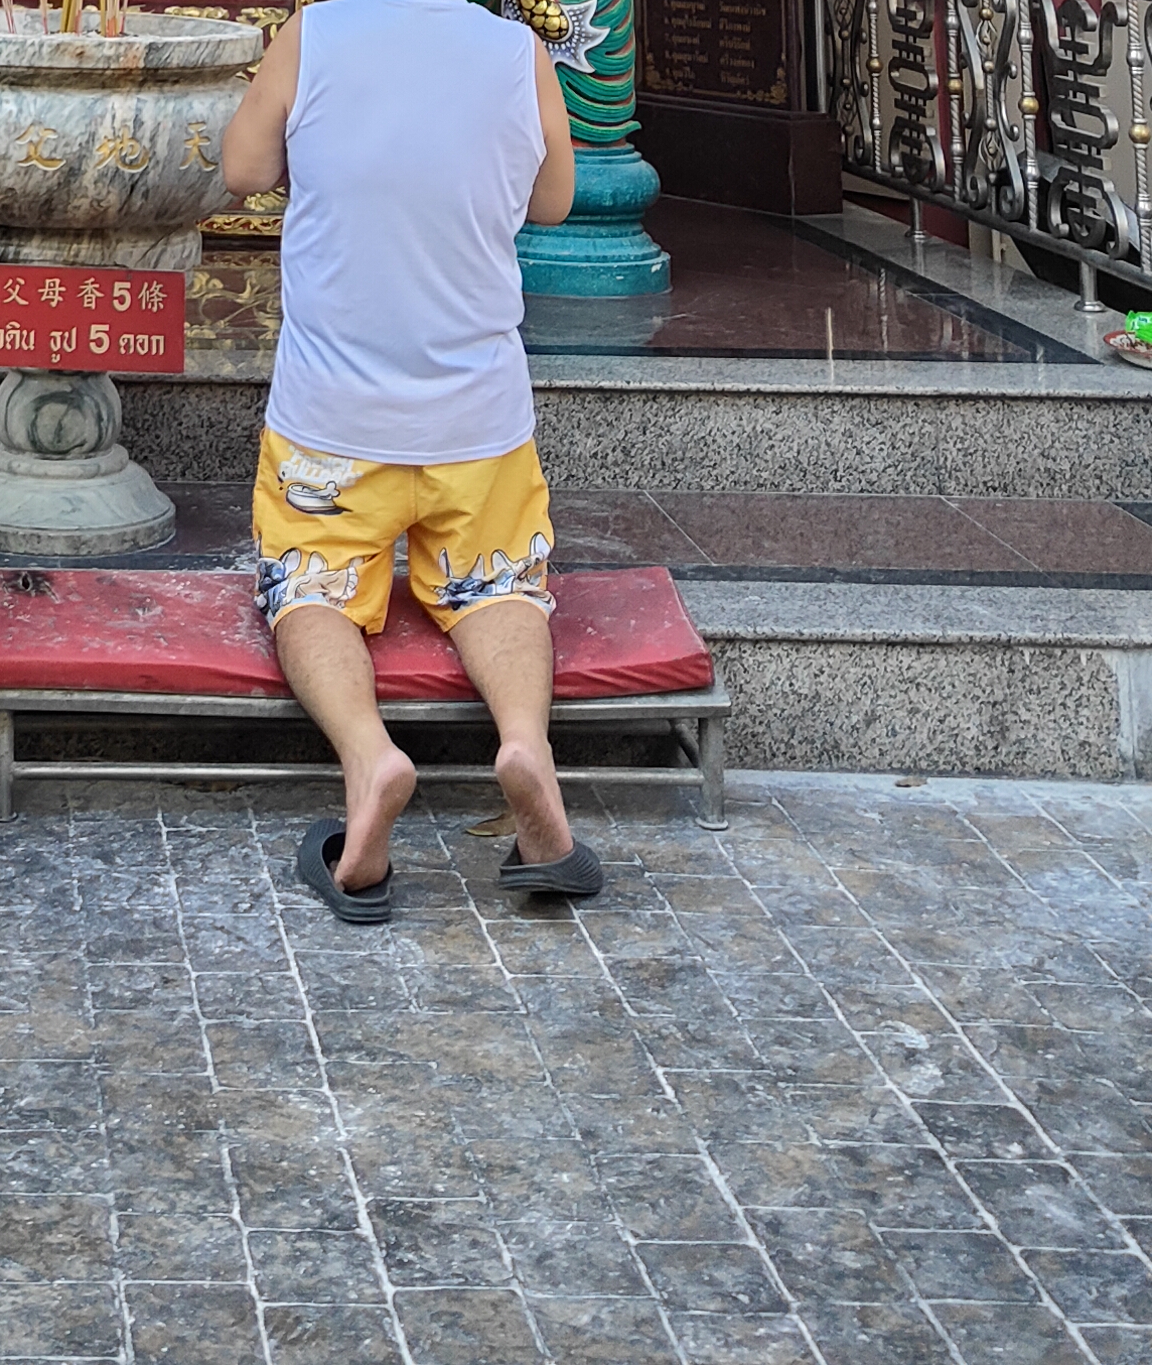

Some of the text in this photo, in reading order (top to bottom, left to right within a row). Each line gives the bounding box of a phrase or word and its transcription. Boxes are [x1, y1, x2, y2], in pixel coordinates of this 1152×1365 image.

[49, 326, 77, 364] ธูป
[88, 324, 111, 355] 5
[119, 333, 165, 356] ดอก
